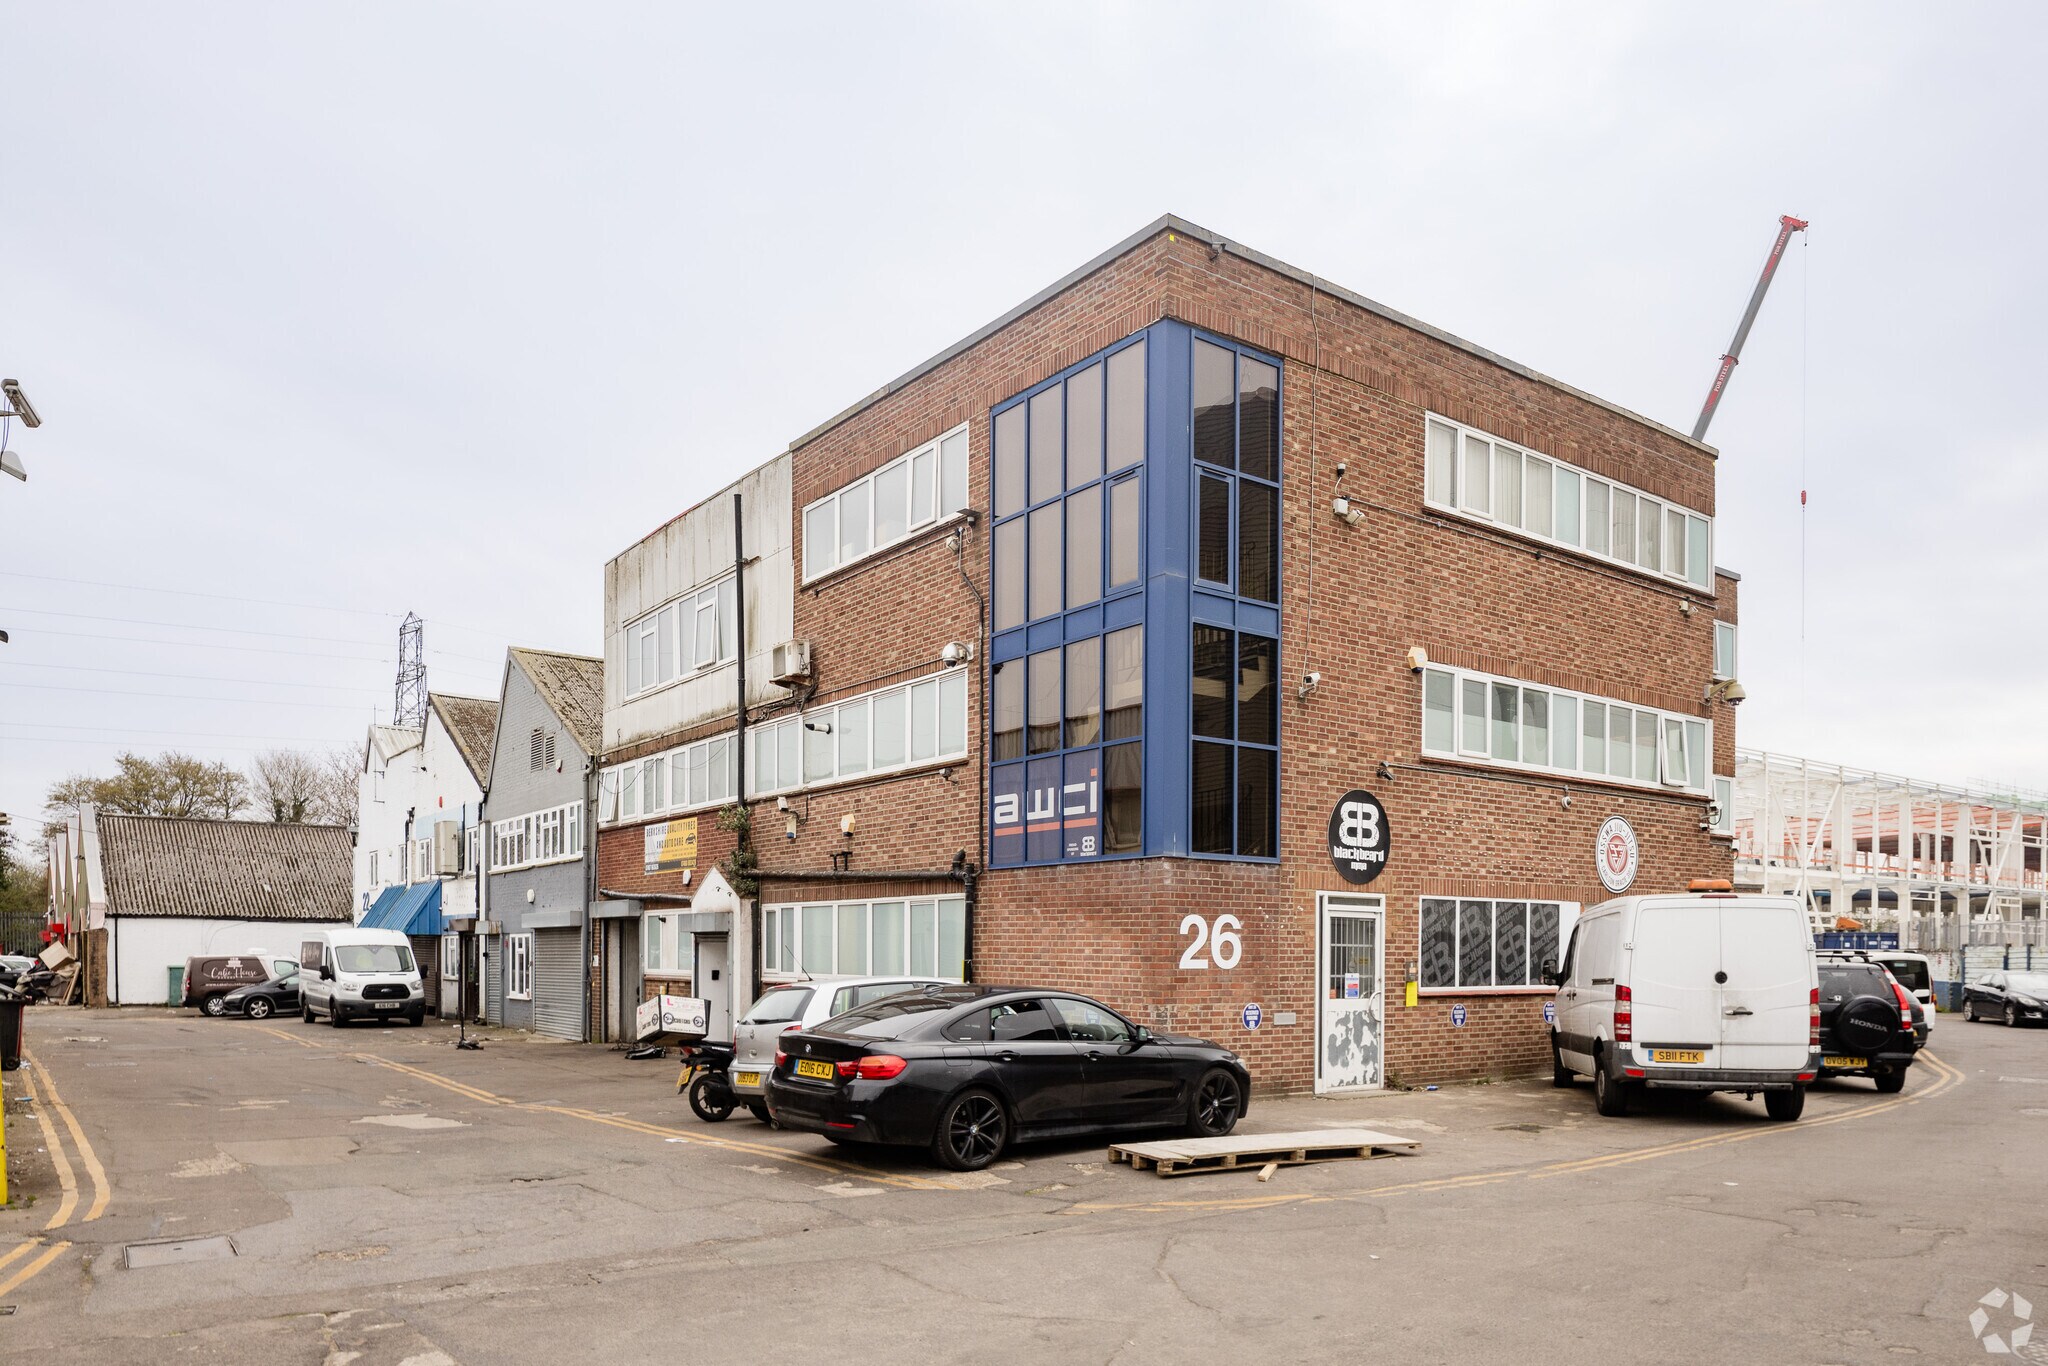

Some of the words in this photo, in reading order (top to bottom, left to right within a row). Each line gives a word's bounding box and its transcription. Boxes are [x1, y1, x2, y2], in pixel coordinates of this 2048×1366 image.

[1333, 845, 1385, 863] blackbeard
[1179, 914, 1242, 969] 26
[211, 967, 232, 979] Cake
[234, 967, 257, 979] House
[1849, 1018, 1888, 1032] HONDA
[1680, 1051, 1699, 1061] FTK
[816, 1063, 831, 1076] CXJ
